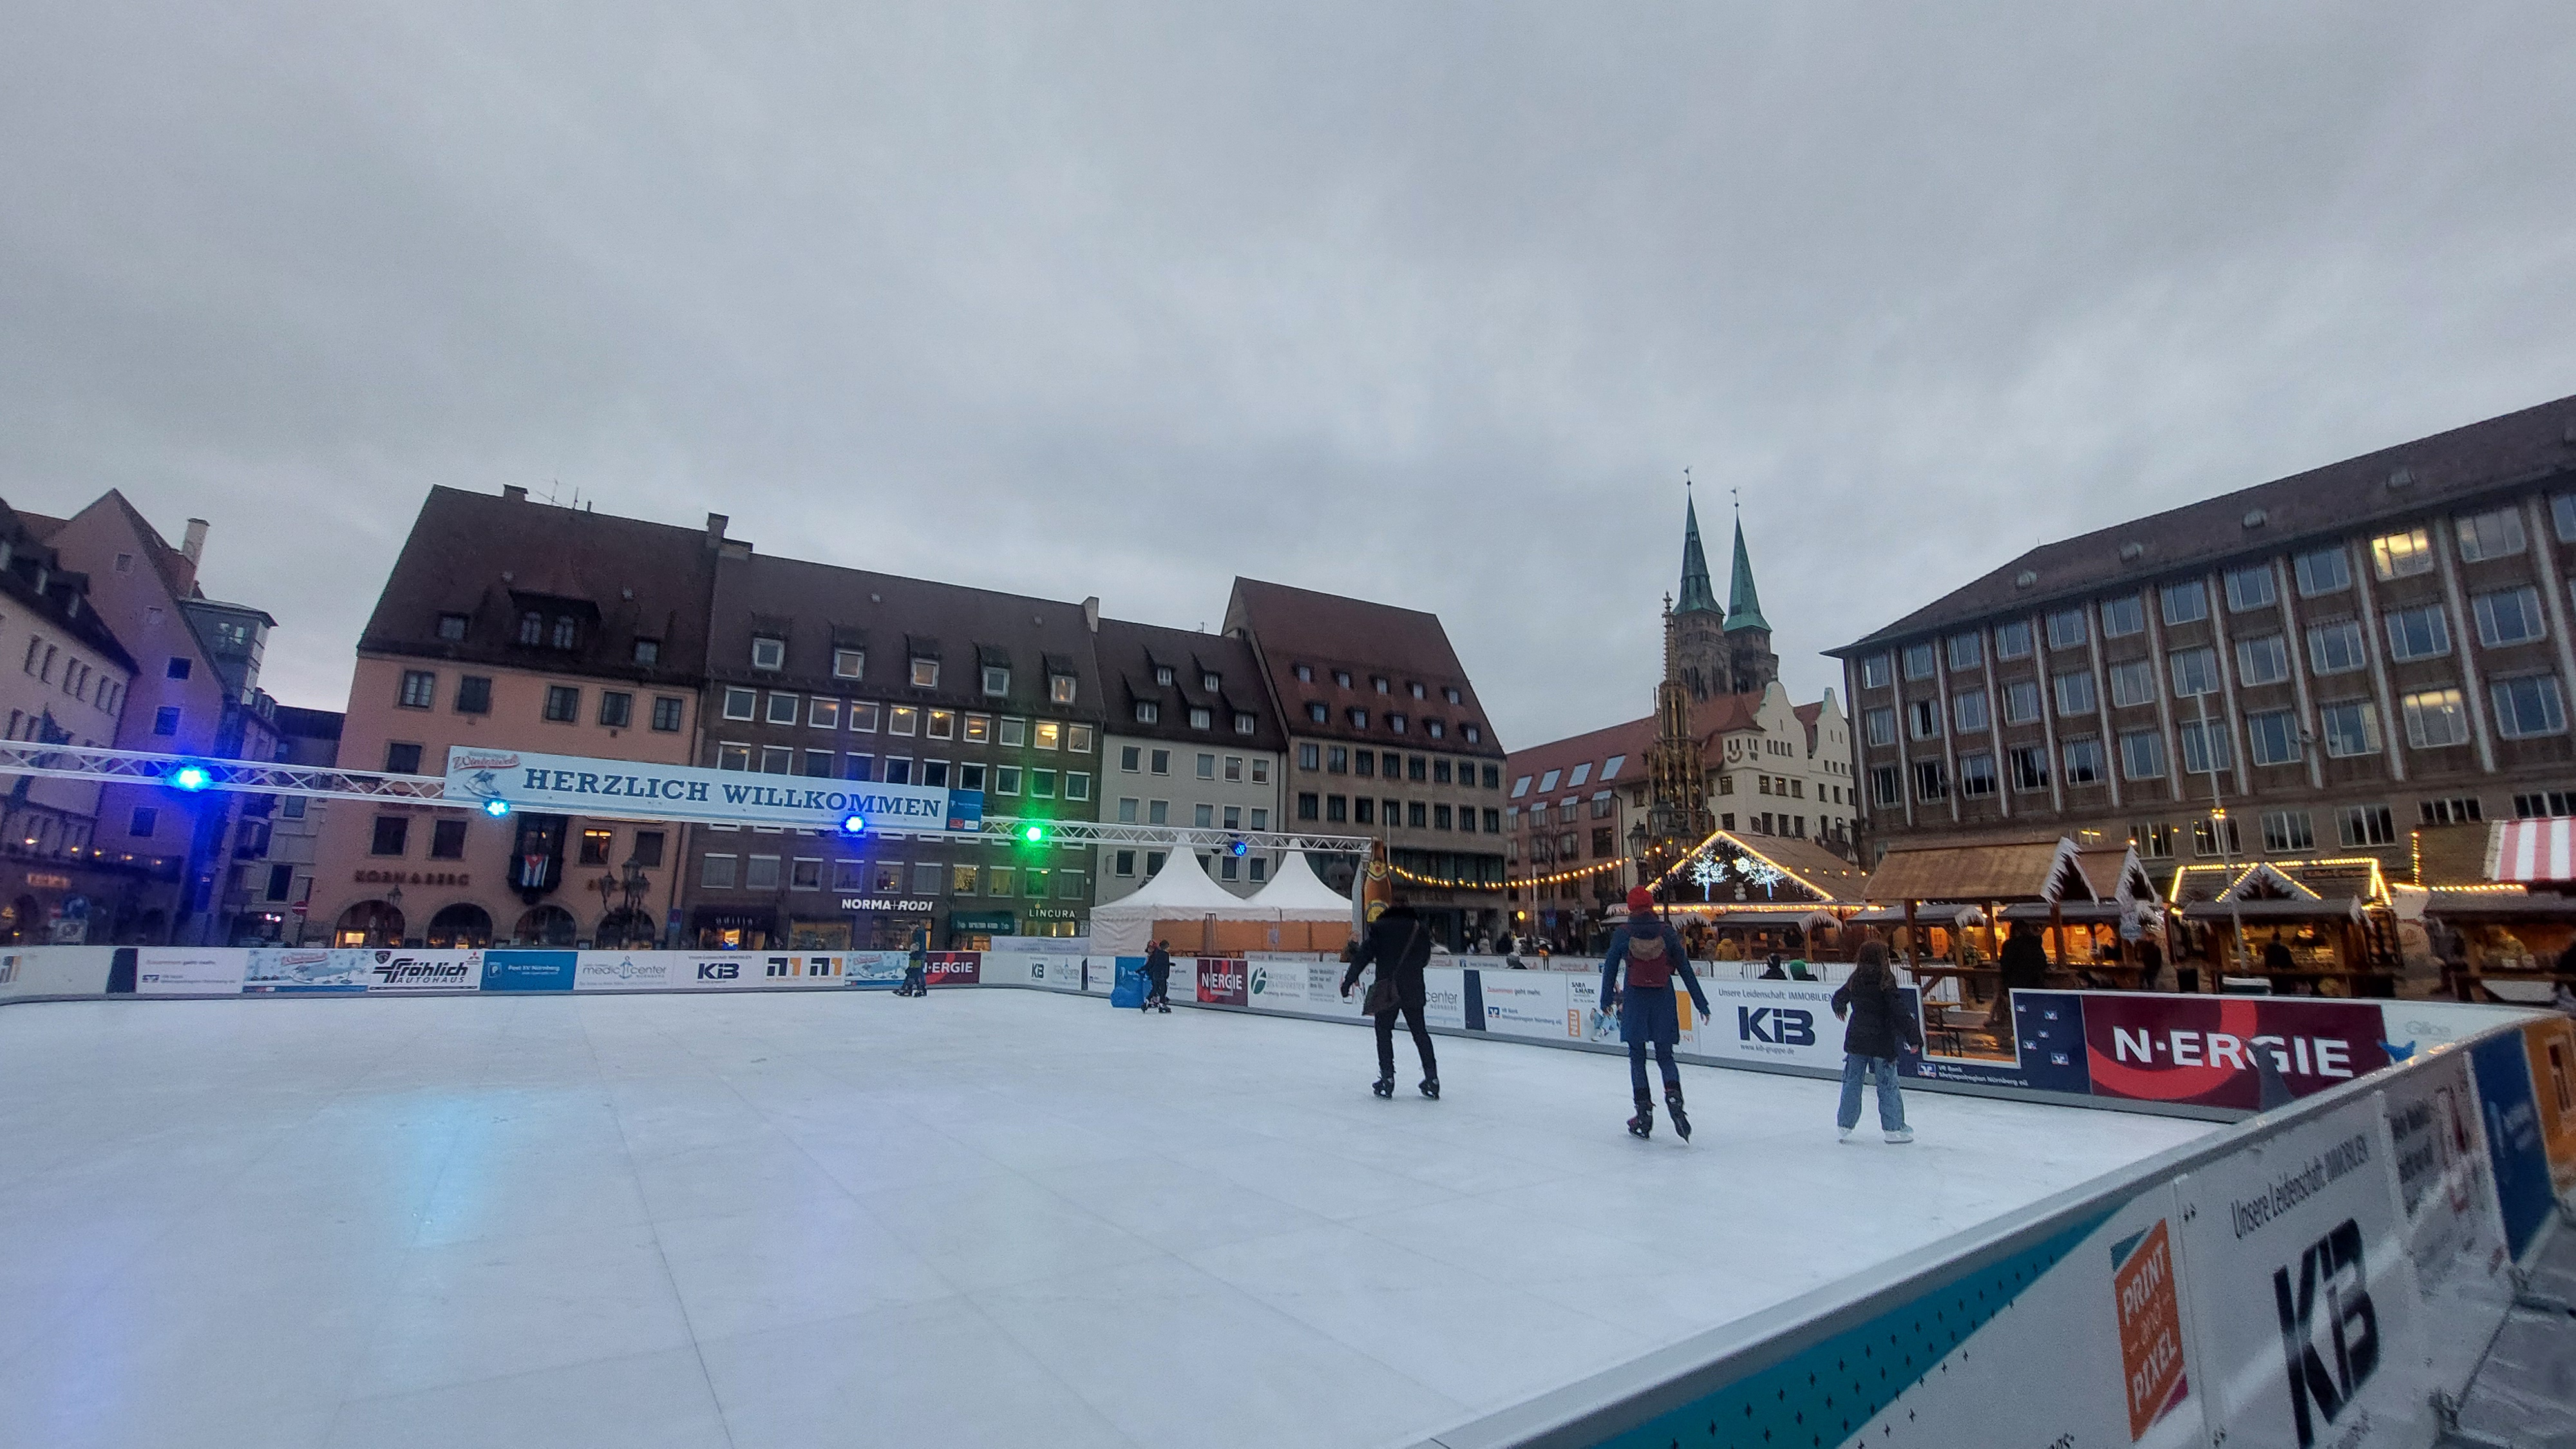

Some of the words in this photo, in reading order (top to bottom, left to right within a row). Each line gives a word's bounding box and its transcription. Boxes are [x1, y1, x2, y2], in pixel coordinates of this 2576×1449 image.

[522, 768, 710, 802] HERZLICH
[722, 783, 942, 818] WILLKOMMEN
[1029, 909, 1076, 918] LINCURA
[370, 958, 468, 983] Fröhlich
[1425, 990, 1458, 1005] center
[1718, 988, 1741, 998] Unsere
[1742, 989, 1786, 1000] Leidenschaft:
[1788, 991, 1833, 1002] IMMOBILIEN
[1569, 1011, 1579, 1036] NEU
[1738, 1005, 1815, 1046] KiB
[2230, 1193, 2271, 1240] Unsere
[2123, 1240, 2165, 1327] PRINT
[2132, 1327, 2178, 1414] PIXEL
